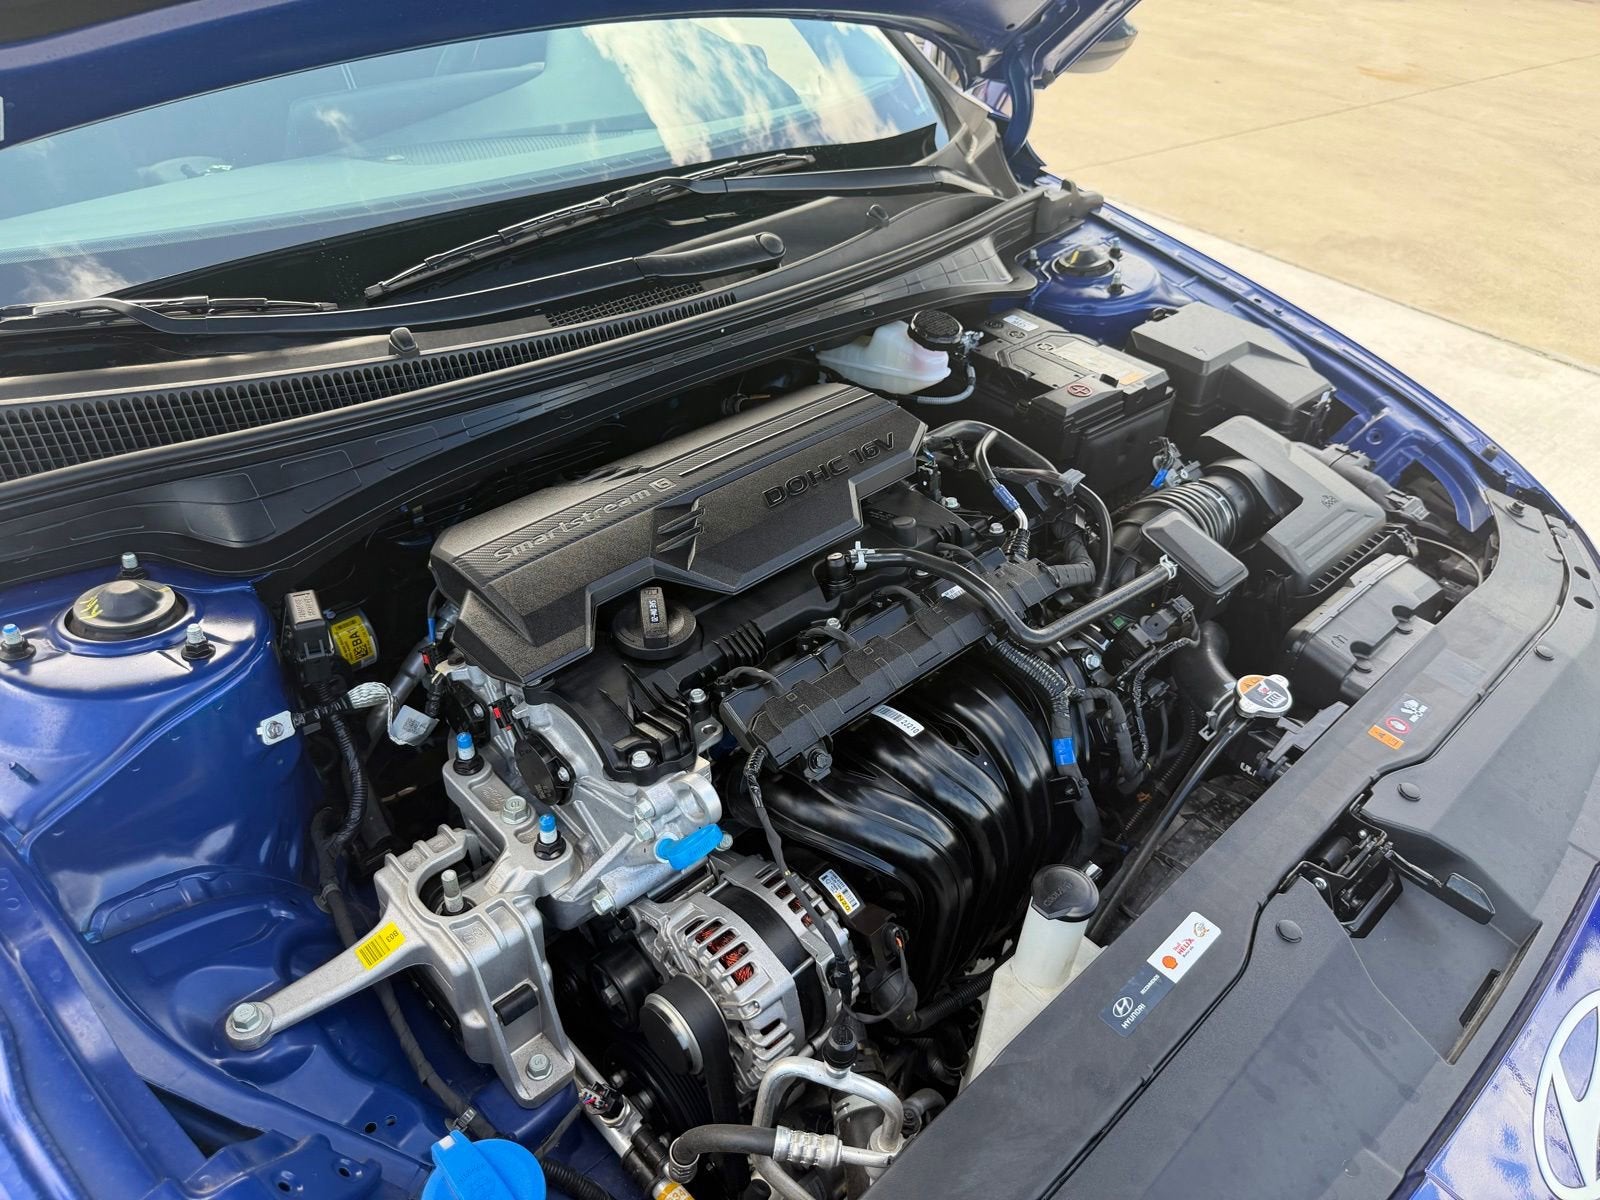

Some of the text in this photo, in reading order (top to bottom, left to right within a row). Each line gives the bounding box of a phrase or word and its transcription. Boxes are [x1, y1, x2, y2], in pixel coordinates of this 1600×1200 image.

[762, 431, 894, 508] DOHC 16V
[493, 488, 651, 564] Smartstream
[1121, 1002, 1146, 1029] HYUNDAI
